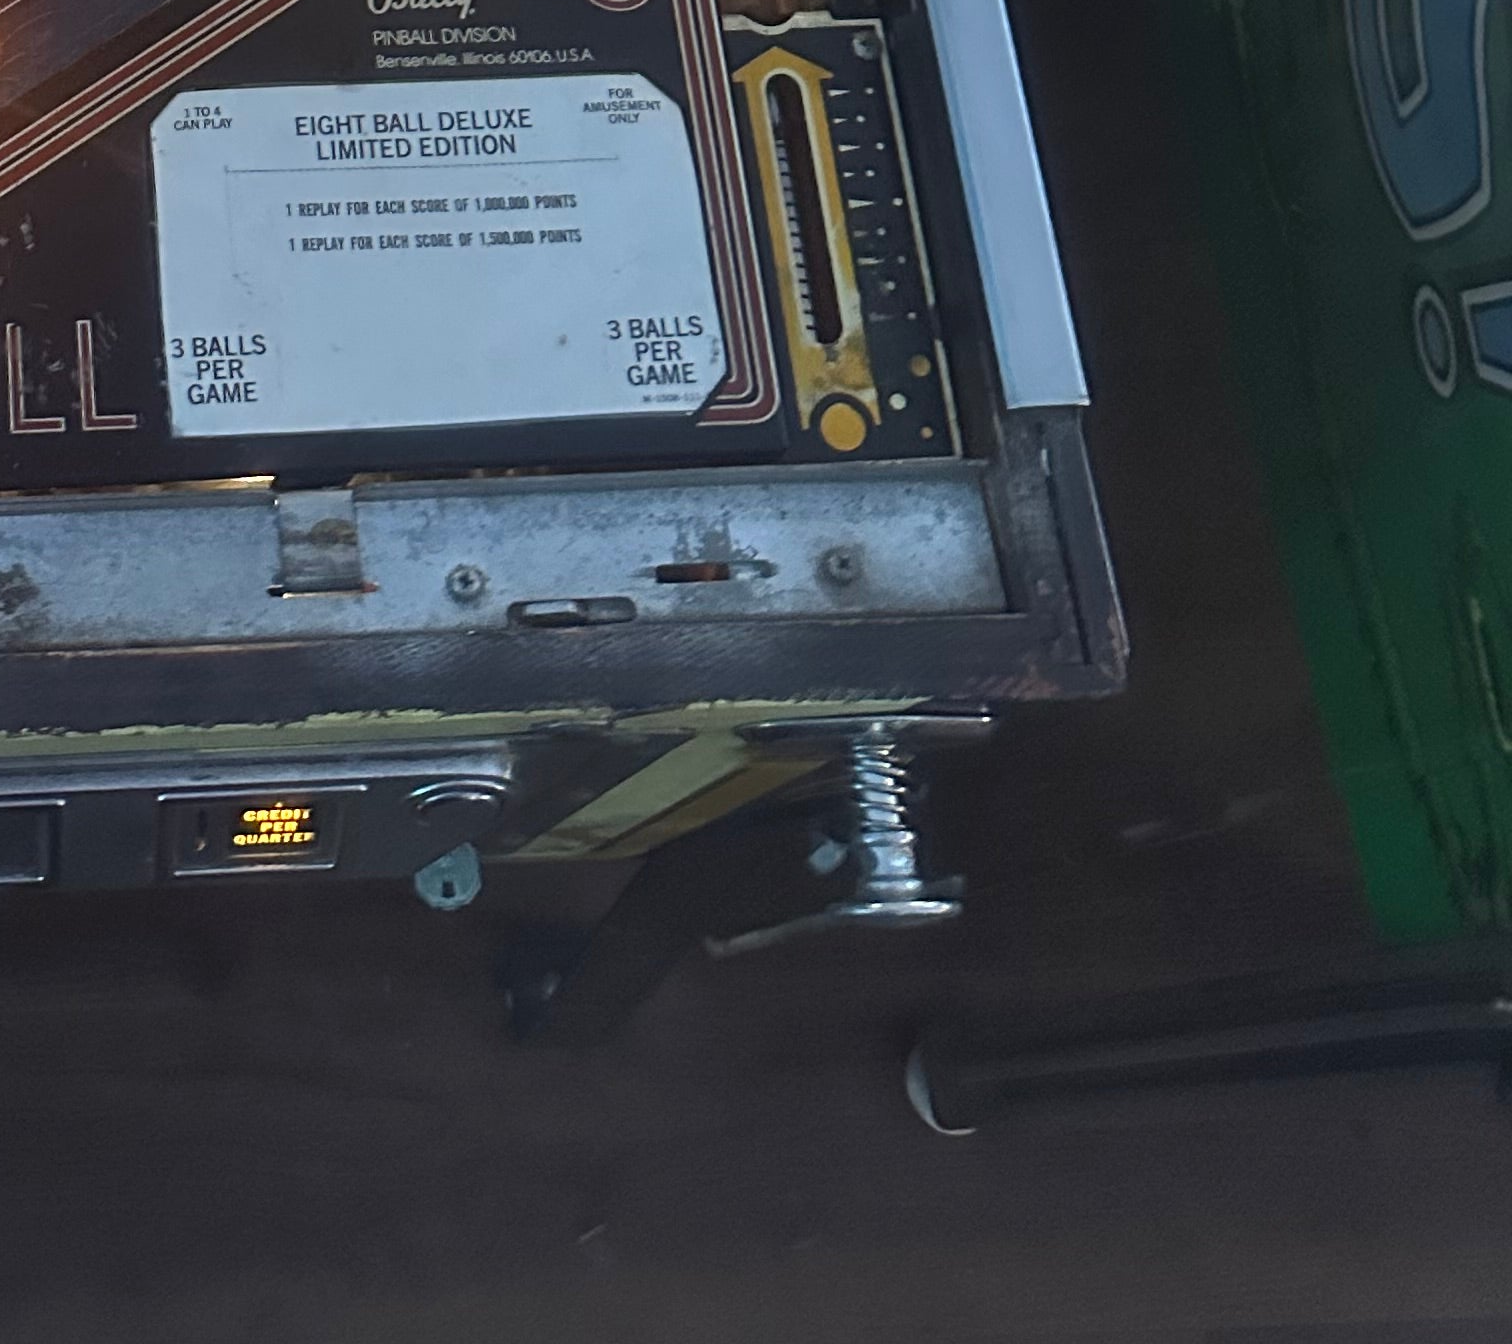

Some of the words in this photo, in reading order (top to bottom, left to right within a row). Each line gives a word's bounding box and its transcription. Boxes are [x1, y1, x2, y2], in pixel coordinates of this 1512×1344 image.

[371, 28, 438, 46] PINBALL
[441, 26, 517, 44] DIVISION
[462, 51, 506, 65] Illinois
[607, 87, 634, 99] FOR
[193, 107, 209, 118] TO
[213, 106, 222, 116] 4
[583, 99, 662, 113] AMUSEMENT
[174, 119, 199, 131] CAN
[202, 117, 233, 130] PLAY
[294, 115, 365, 137] EIGHT
[376, 112, 432, 134] BALL
[437, 108, 533, 132] DELUXE
[608, 112, 640, 124] ONLY
[316, 138, 411, 161] LIMITED
[419, 134, 517, 158] EDITION
[298, 201, 341, 217] REPLAY
[347, 201, 370, 215] FOR
[376, 199, 405, 214] EACH
[411, 197, 449, 213] SCORE
[455, 197, 469, 212] OF
[534, 193, 578, 210] POINTS
[302, 236, 345, 252] REPLAY
[350, 235, 374, 250] FOR
[380, 233, 409, 248] EACH
[415, 232, 453, 248] SCORE
[459, 232, 473, 247] OF
[539, 228, 582, 244] POINTS
[607, 320, 622, 340] 3
[628, 315, 704, 339] BALLS
[170, 337, 185, 358] 3
[192, 334, 267, 356] BALLS
[635, 340, 683, 362] PER
[196, 359, 244, 379] PER
[627, 362, 698, 386] GAME
[188, 382, 258, 404] GAME
[243, 808, 312, 821] CREDIT
[260, 821, 298, 832] PER
